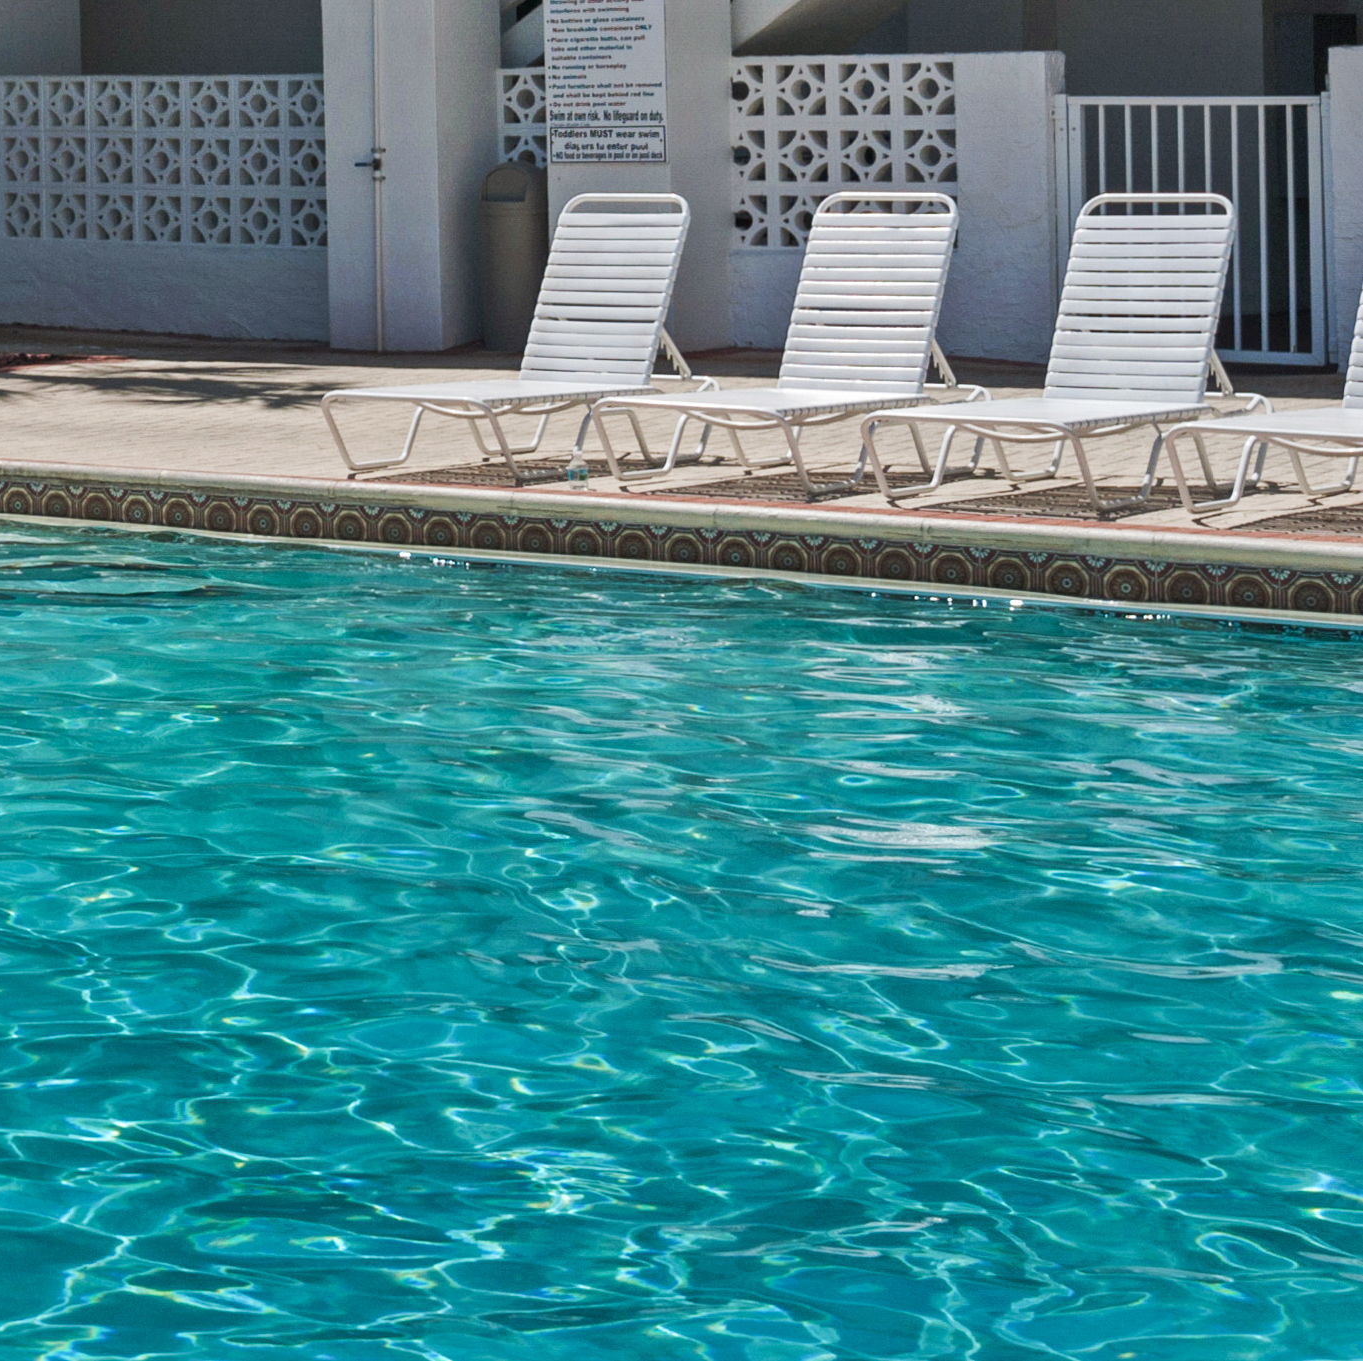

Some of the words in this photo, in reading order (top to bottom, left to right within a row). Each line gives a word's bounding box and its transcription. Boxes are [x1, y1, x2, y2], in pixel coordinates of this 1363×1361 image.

[570, 36, 599, 44] cigarette
[634, 34, 645, 42] pull
[596, 63, 627, 71] horseplay
[550, 110, 565, 121] Swim
[574, 112, 586, 121] own
[587, 110, 600, 121] risk.
[612, 110, 639, 124] lifeguard
[649, 110, 664, 124] duty.
[554, 129, 588, 138] Toddlers
[589, 129, 613, 138] MUST
[638, 130, 660, 138] swim
[630, 142, 649, 152] pool
[564, 151, 575, 159] food
[582, 151, 607, 160] beverages
[613, 151, 624, 160] pool
[639, 151, 650, 160] pool
[651, 151, 663, 159] deck
